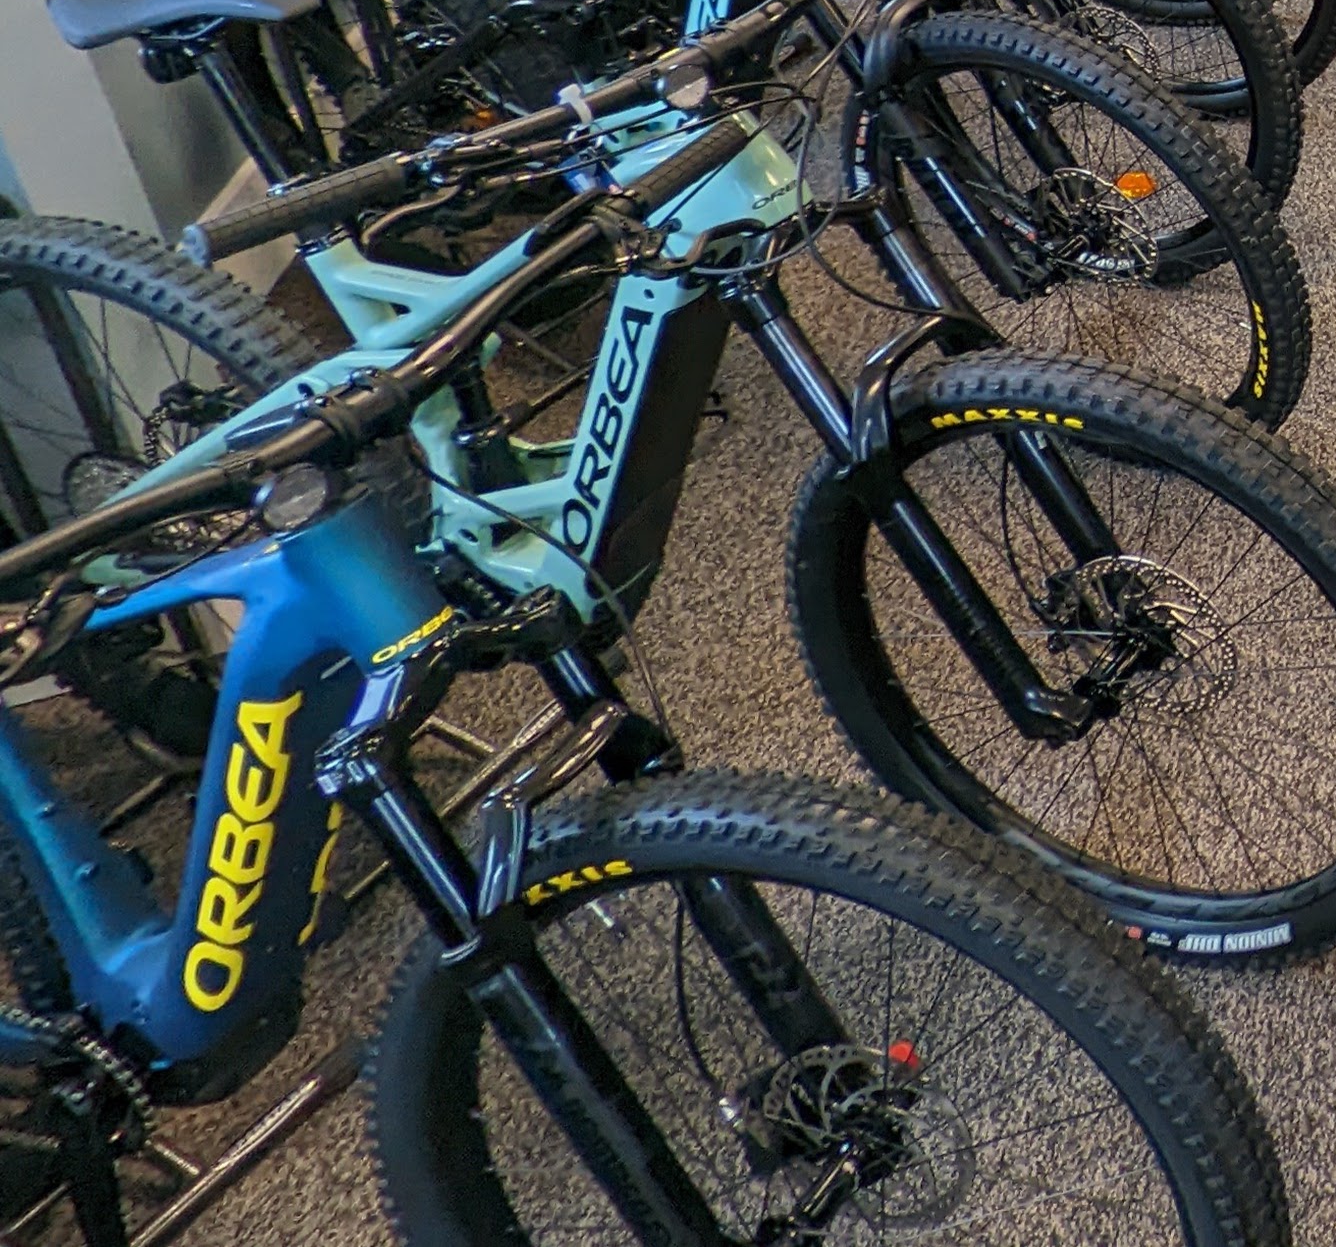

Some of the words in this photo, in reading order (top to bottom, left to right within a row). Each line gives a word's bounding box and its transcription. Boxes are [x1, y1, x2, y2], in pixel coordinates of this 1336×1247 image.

[1252, 299, 1268, 398] MAXXIS
[562, 306, 654, 555] ORBEA
[931, 407, 1085, 429] MAXXIS
[183, 691, 302, 1012] ORBEA
[523, 859, 633, 907] XXIS
